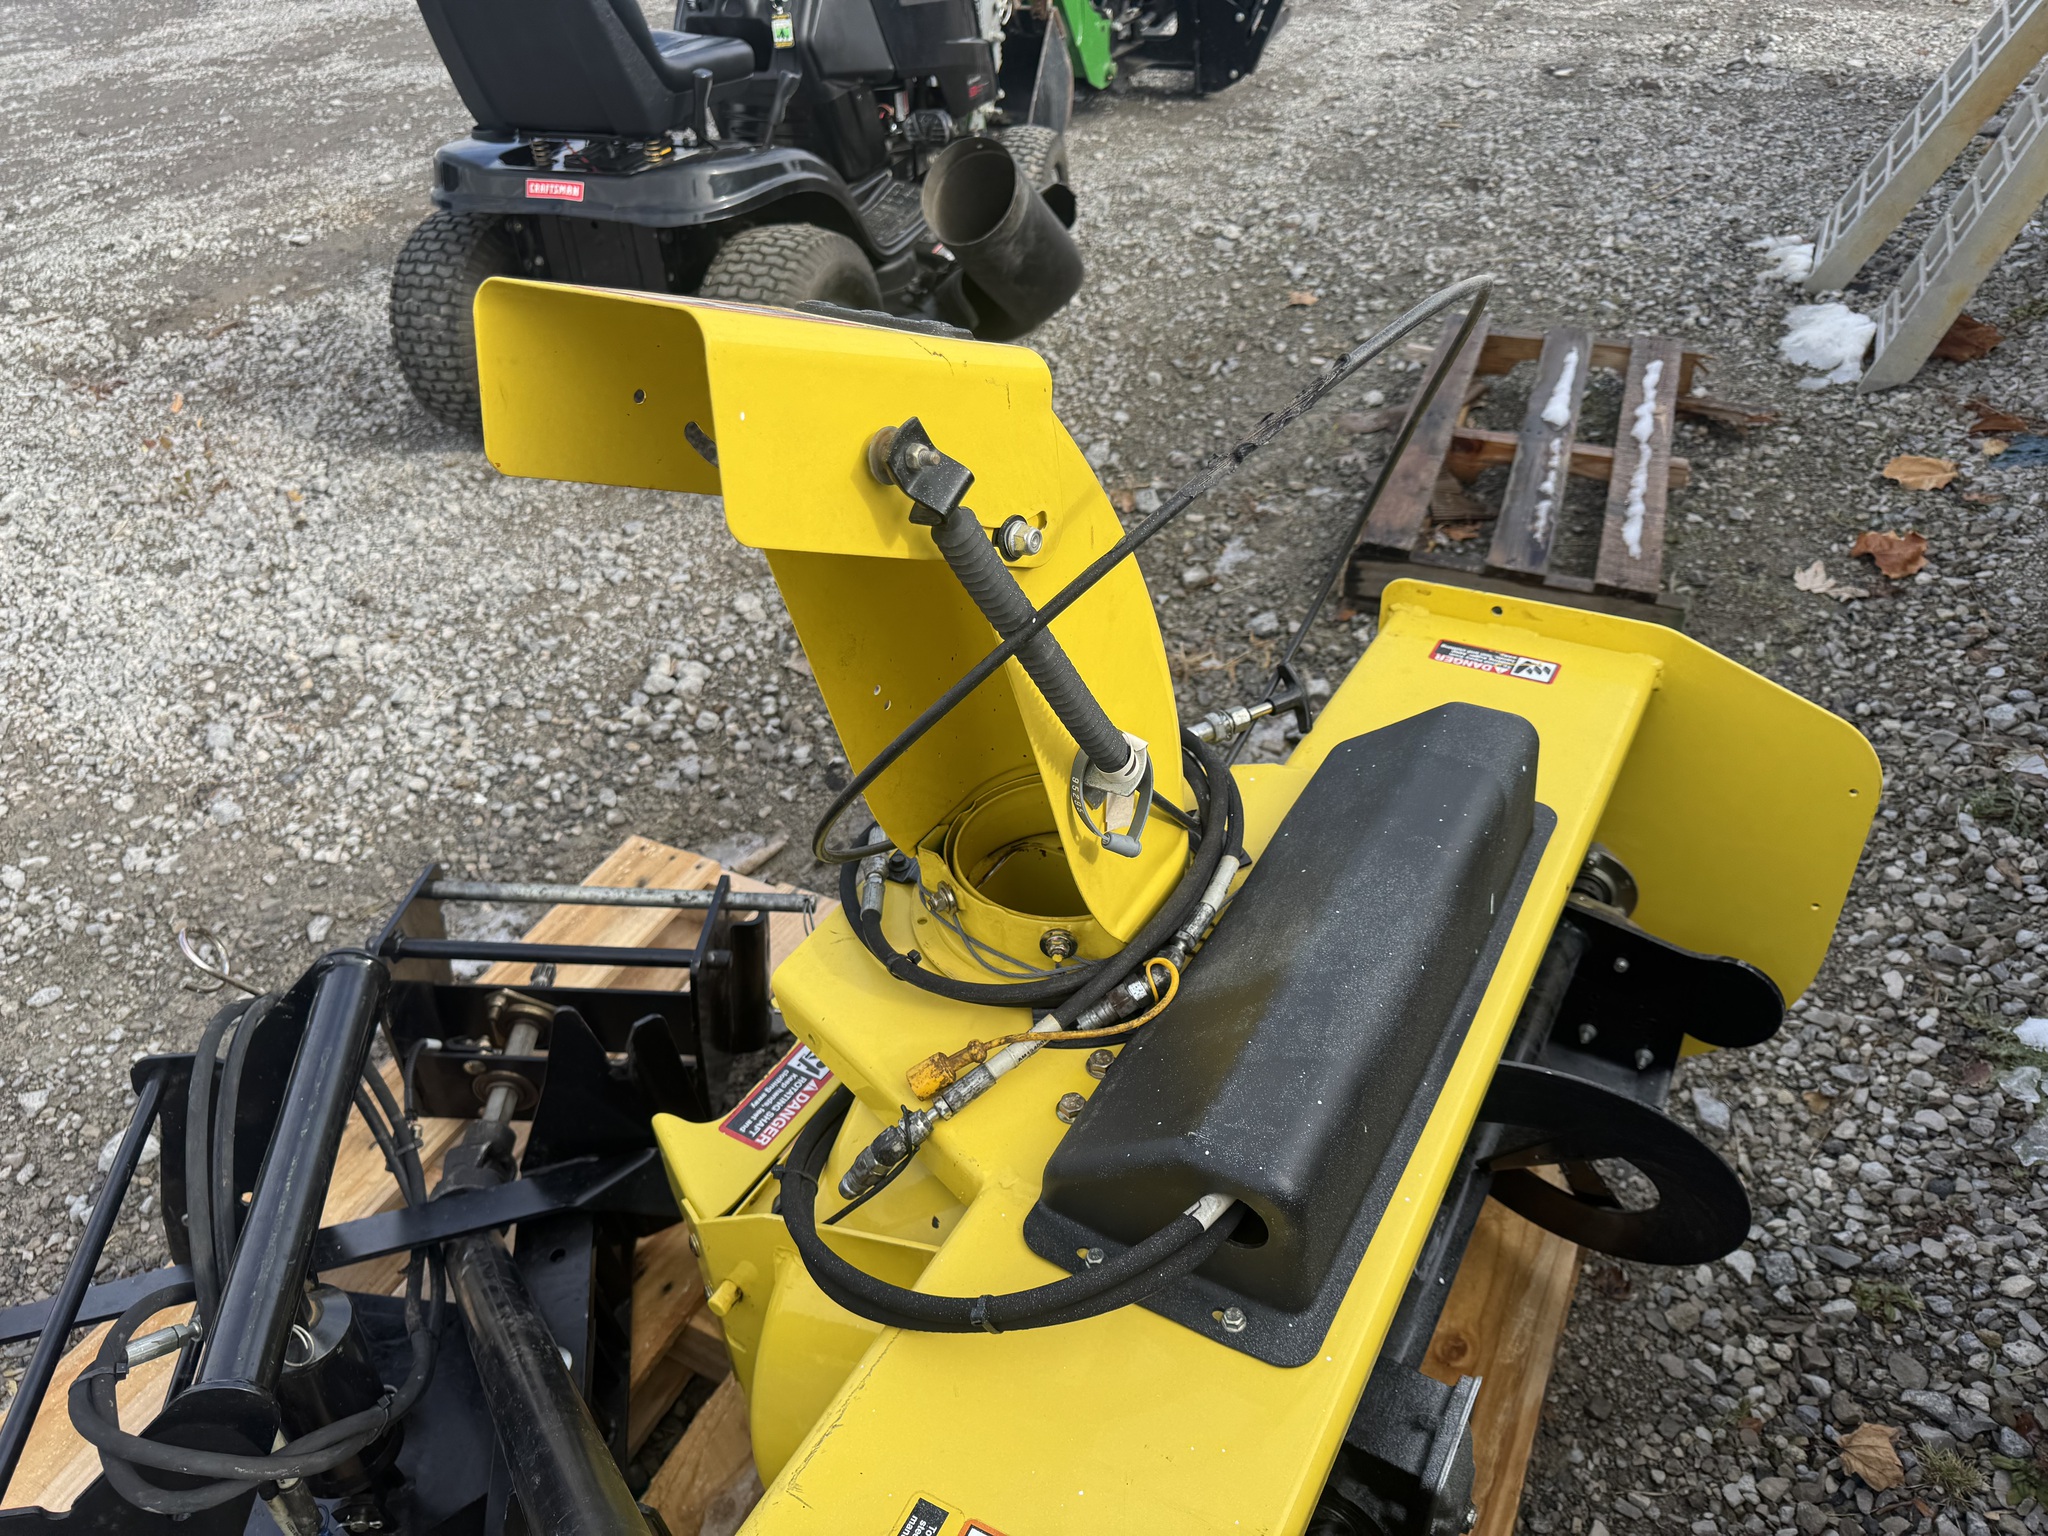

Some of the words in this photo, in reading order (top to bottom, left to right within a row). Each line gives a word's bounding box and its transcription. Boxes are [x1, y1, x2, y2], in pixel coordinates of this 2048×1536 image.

[529, 182, 580, 197] CRAFTSMAN
[1434, 653, 1493, 672] DANGER
[764, 1069, 789, 1093] clothing
[781, 1073, 798, 1088] Keep
[750, 1093, 767, 1108] away
[761, 1089, 783, 1108] hands,
[772, 1076, 807, 1112] ROTATING
[749, 1110, 774, 1137] SHAFT
[751, 1108, 765, 1121] feet
[755, 1092, 810, 1146] DANGER
[739, 1120, 753, 1132] and
[900, 1514, 919, 1536] man
